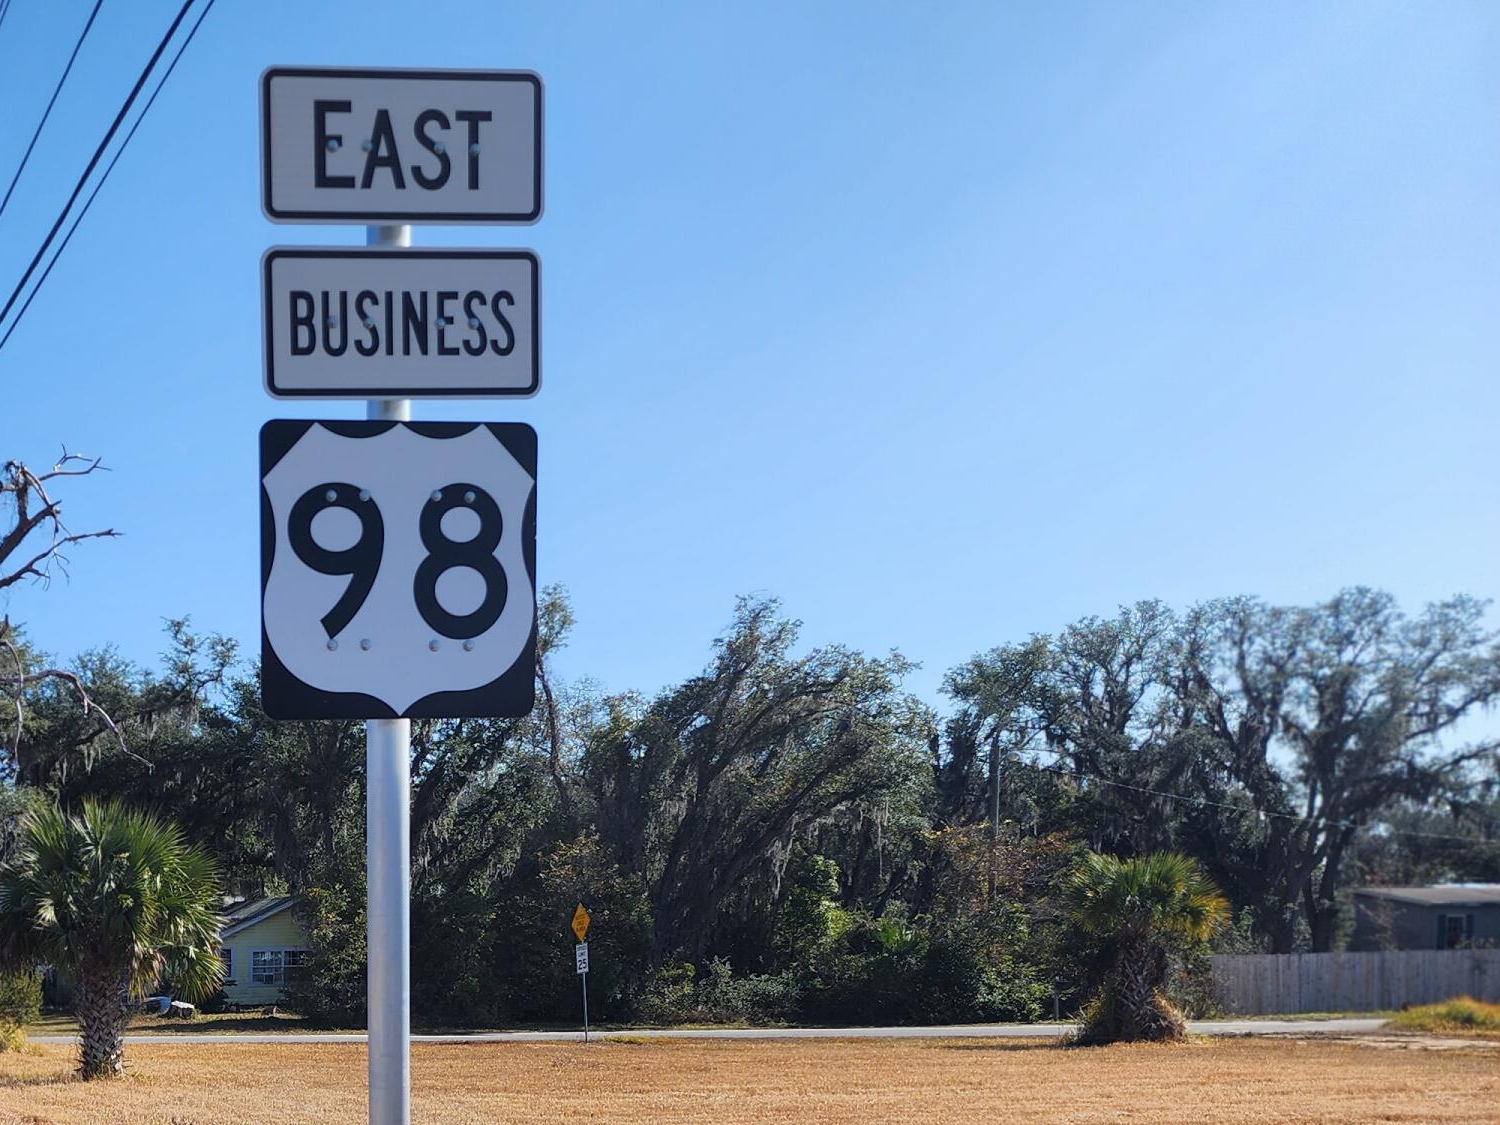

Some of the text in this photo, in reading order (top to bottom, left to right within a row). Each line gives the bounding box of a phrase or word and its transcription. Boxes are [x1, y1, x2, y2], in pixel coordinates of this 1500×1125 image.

[313, 99, 493, 191] EAST
[288, 289, 516, 357] BUSINESS
[287, 481, 509, 640] 98
[578, 959, 587, 970] 25
